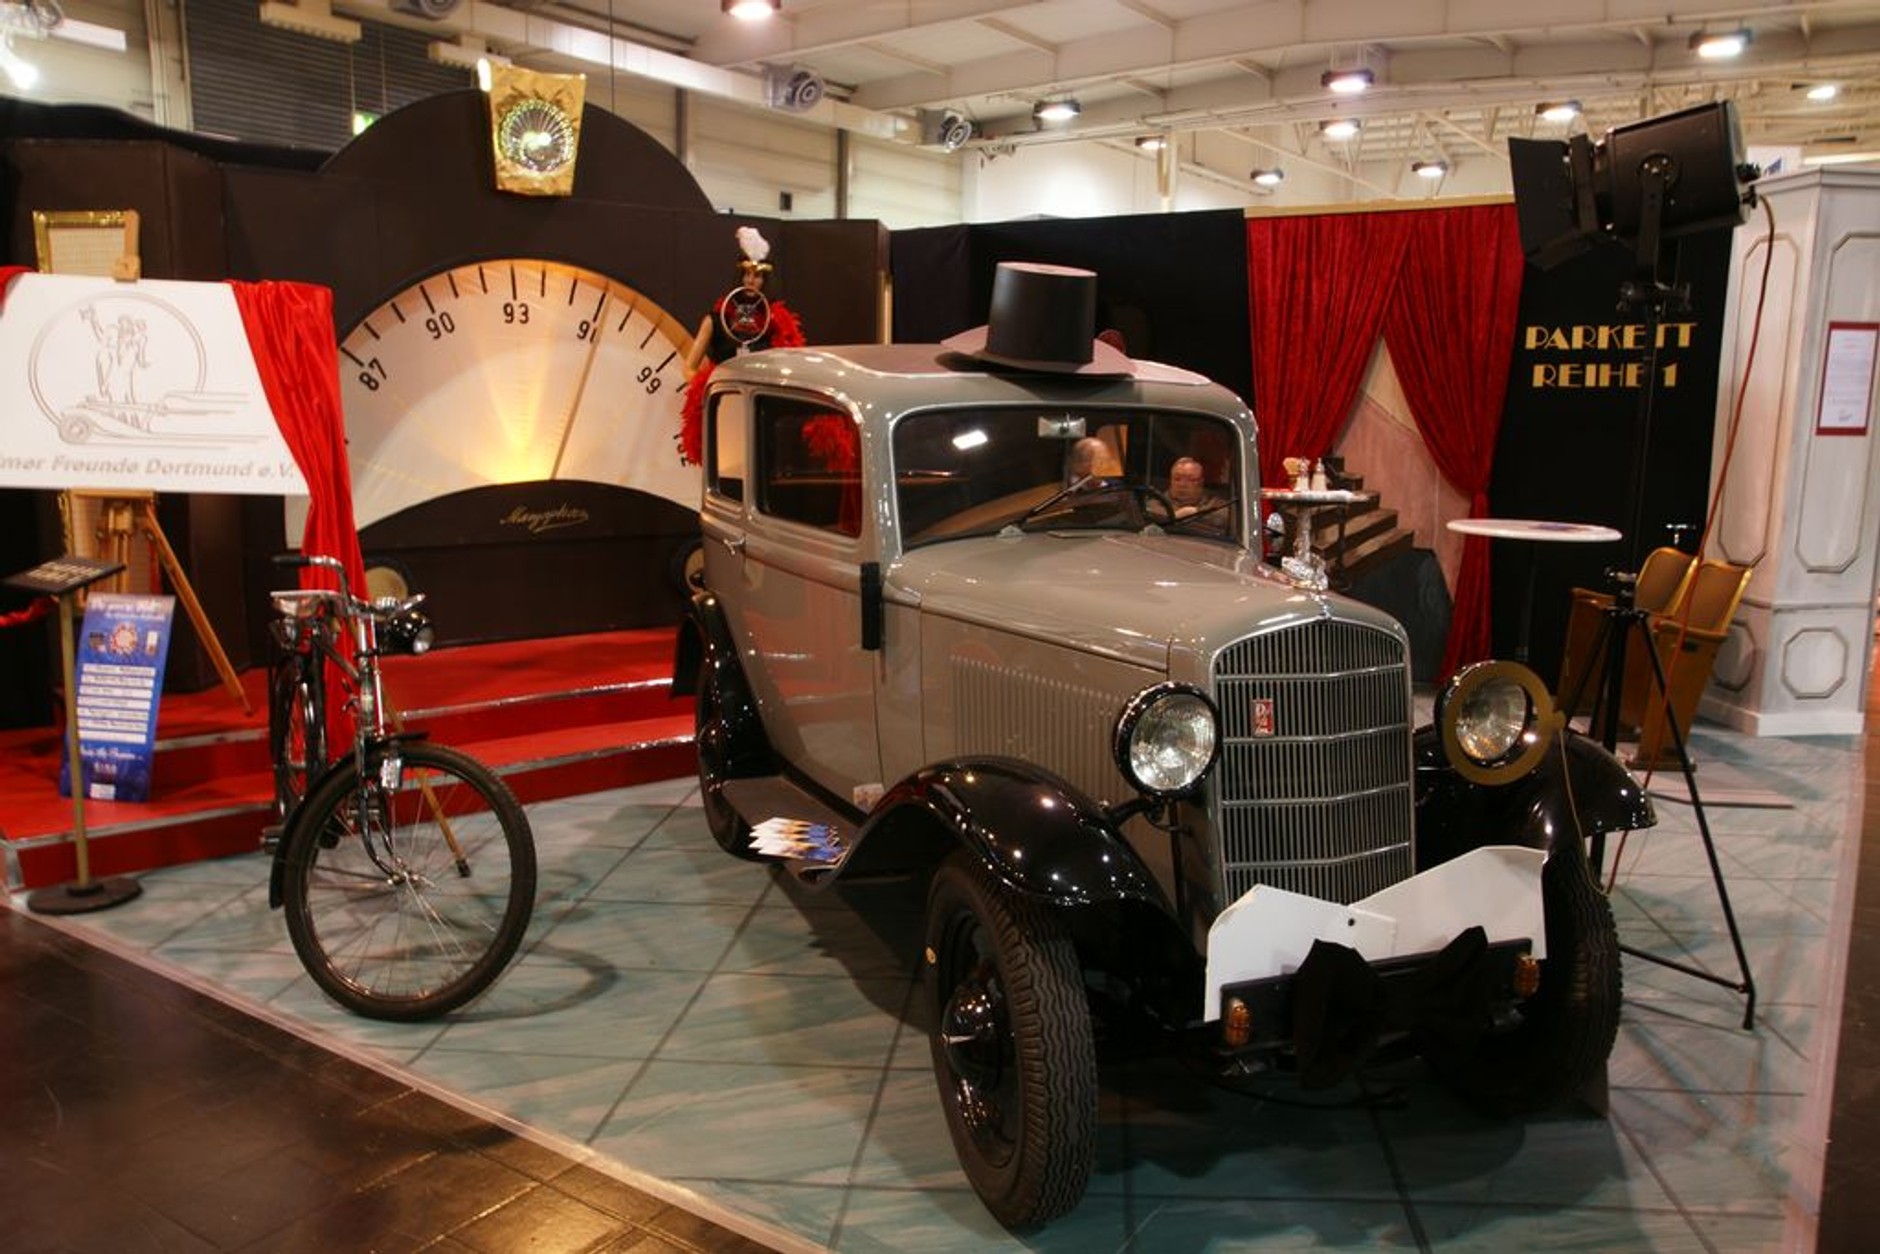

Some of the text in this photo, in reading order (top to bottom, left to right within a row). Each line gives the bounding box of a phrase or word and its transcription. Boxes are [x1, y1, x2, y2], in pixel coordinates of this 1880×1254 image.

[426, 312, 455, 339] 90
[503, 303, 529, 324] 93
[1525, 322, 1697, 350] PARKETT
[359, 358, 387, 391] 87
[636, 366, 662, 394] 99
[1532, 362, 1678, 388] REIHE 1
[52, 454, 139, 473] Freunde
[145, 457, 254, 477] Dortmund
